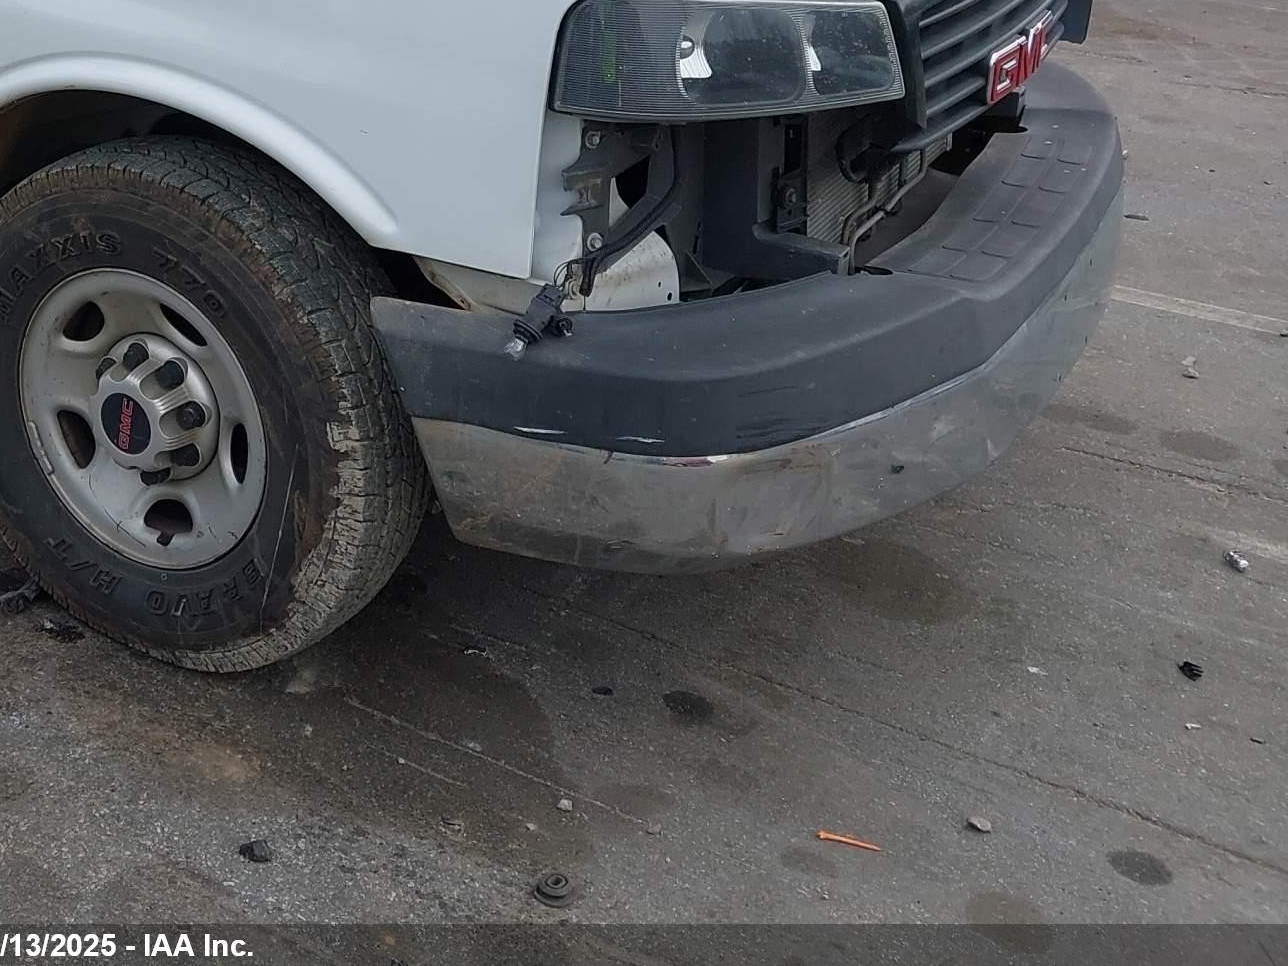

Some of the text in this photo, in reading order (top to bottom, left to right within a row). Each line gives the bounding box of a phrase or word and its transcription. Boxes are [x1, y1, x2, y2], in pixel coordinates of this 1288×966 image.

[987, 9, 1053, 105] GMC
[152, 244, 227, 318] 770
[118, 396, 134, 450] GMC
[45, 536, 123, 595] H/T
